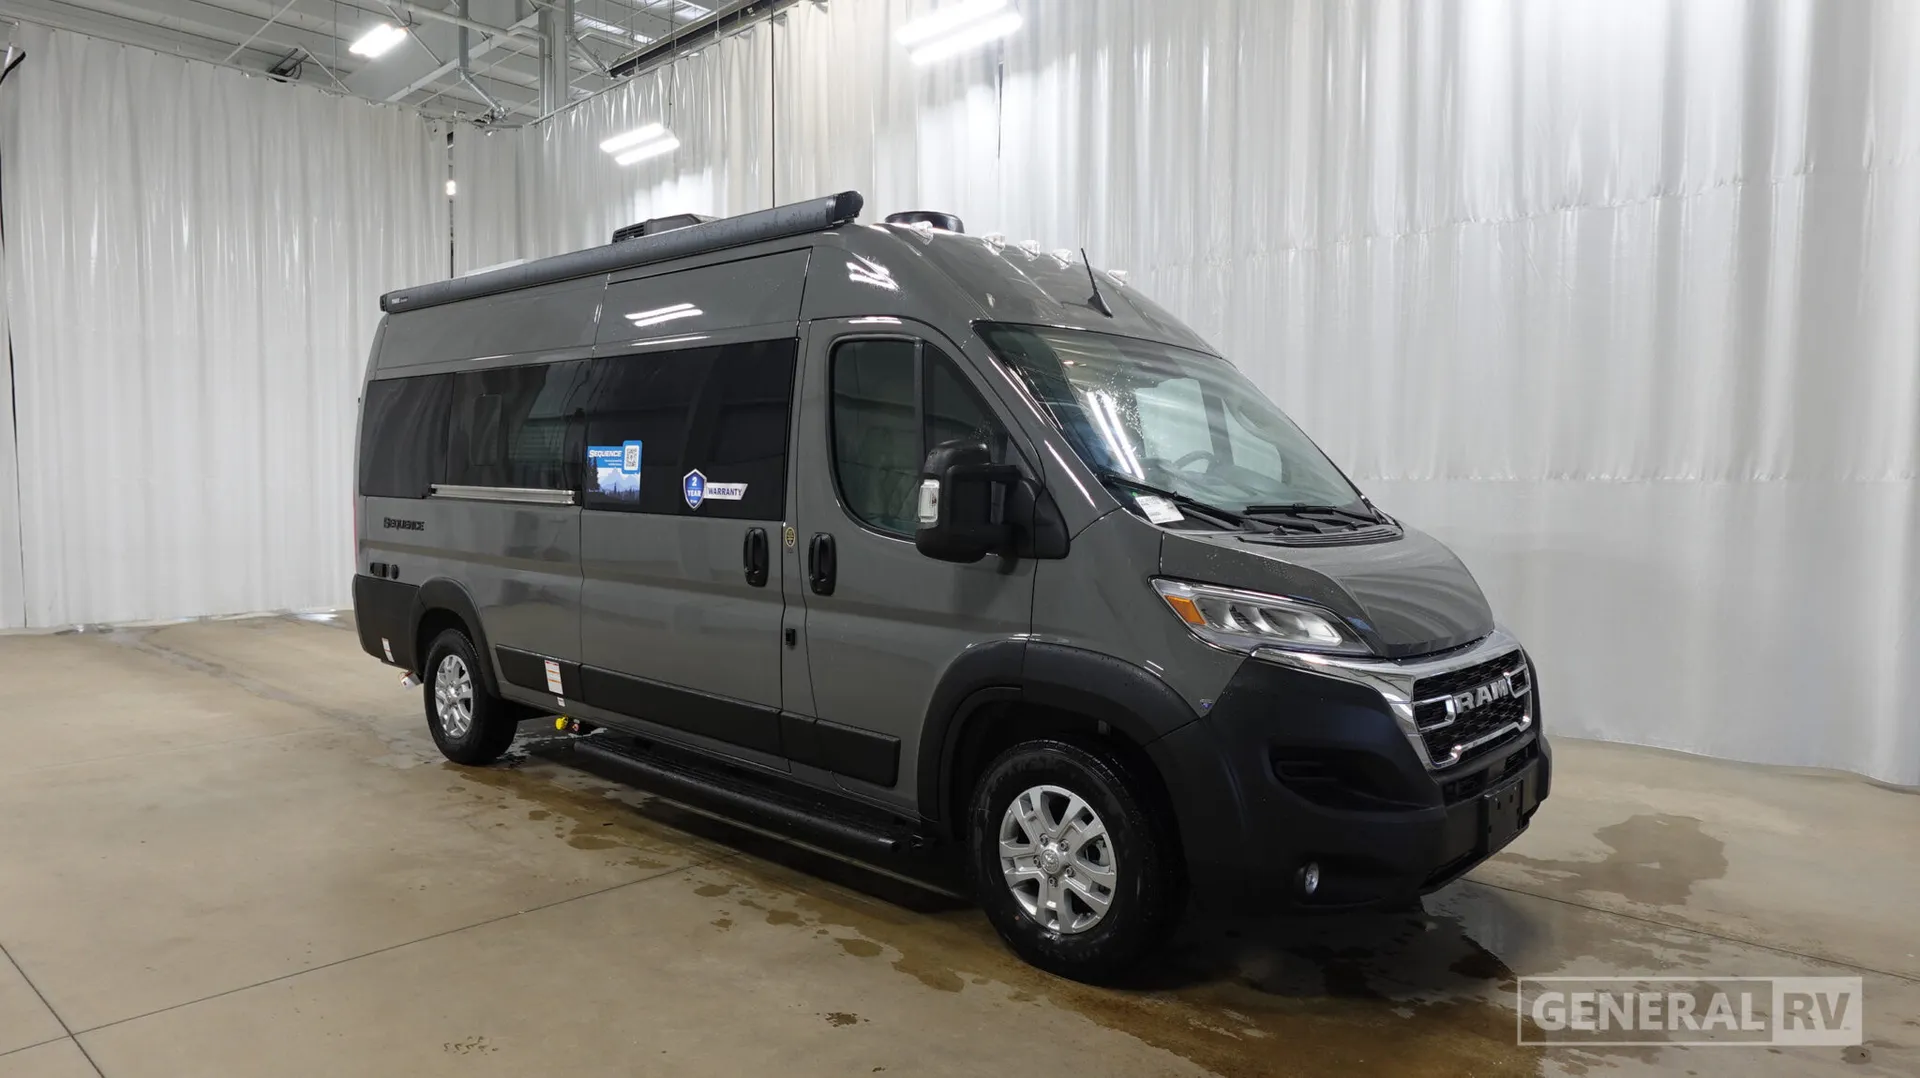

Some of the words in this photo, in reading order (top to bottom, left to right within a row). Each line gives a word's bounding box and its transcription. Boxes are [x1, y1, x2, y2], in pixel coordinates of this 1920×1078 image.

[588, 449, 622, 458] SEQUENCE
[691, 476, 698, 487] 2
[708, 487, 742, 496] WARRANTY
[1453, 678, 1509, 714] RAM
